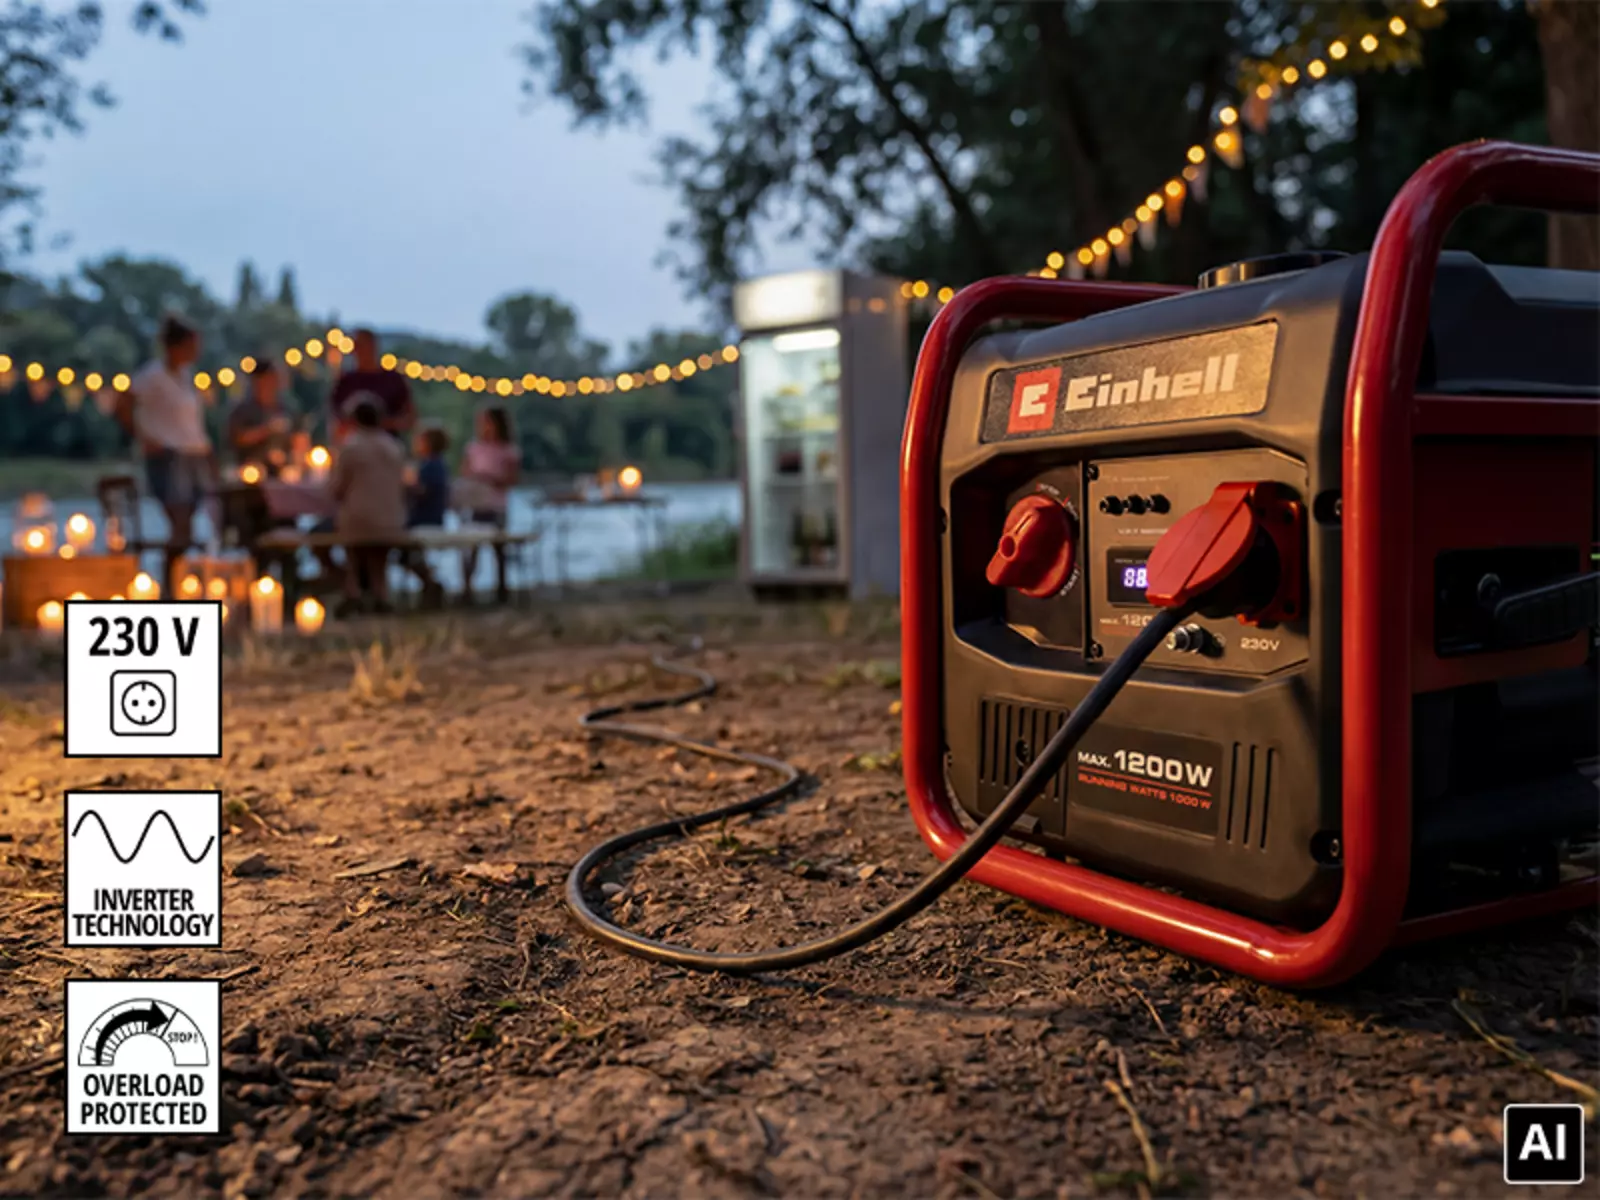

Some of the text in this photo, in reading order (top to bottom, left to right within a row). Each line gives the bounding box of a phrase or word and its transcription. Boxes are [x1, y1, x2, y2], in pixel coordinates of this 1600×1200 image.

[1064, 353, 1239, 412] Einhell
[1240, 637, 1280, 651] 230V
[1077, 751, 1112, 768] MAX.
[1077, 773, 1127, 792] RUNNING
[1129, 784, 1167, 800] WATTS
